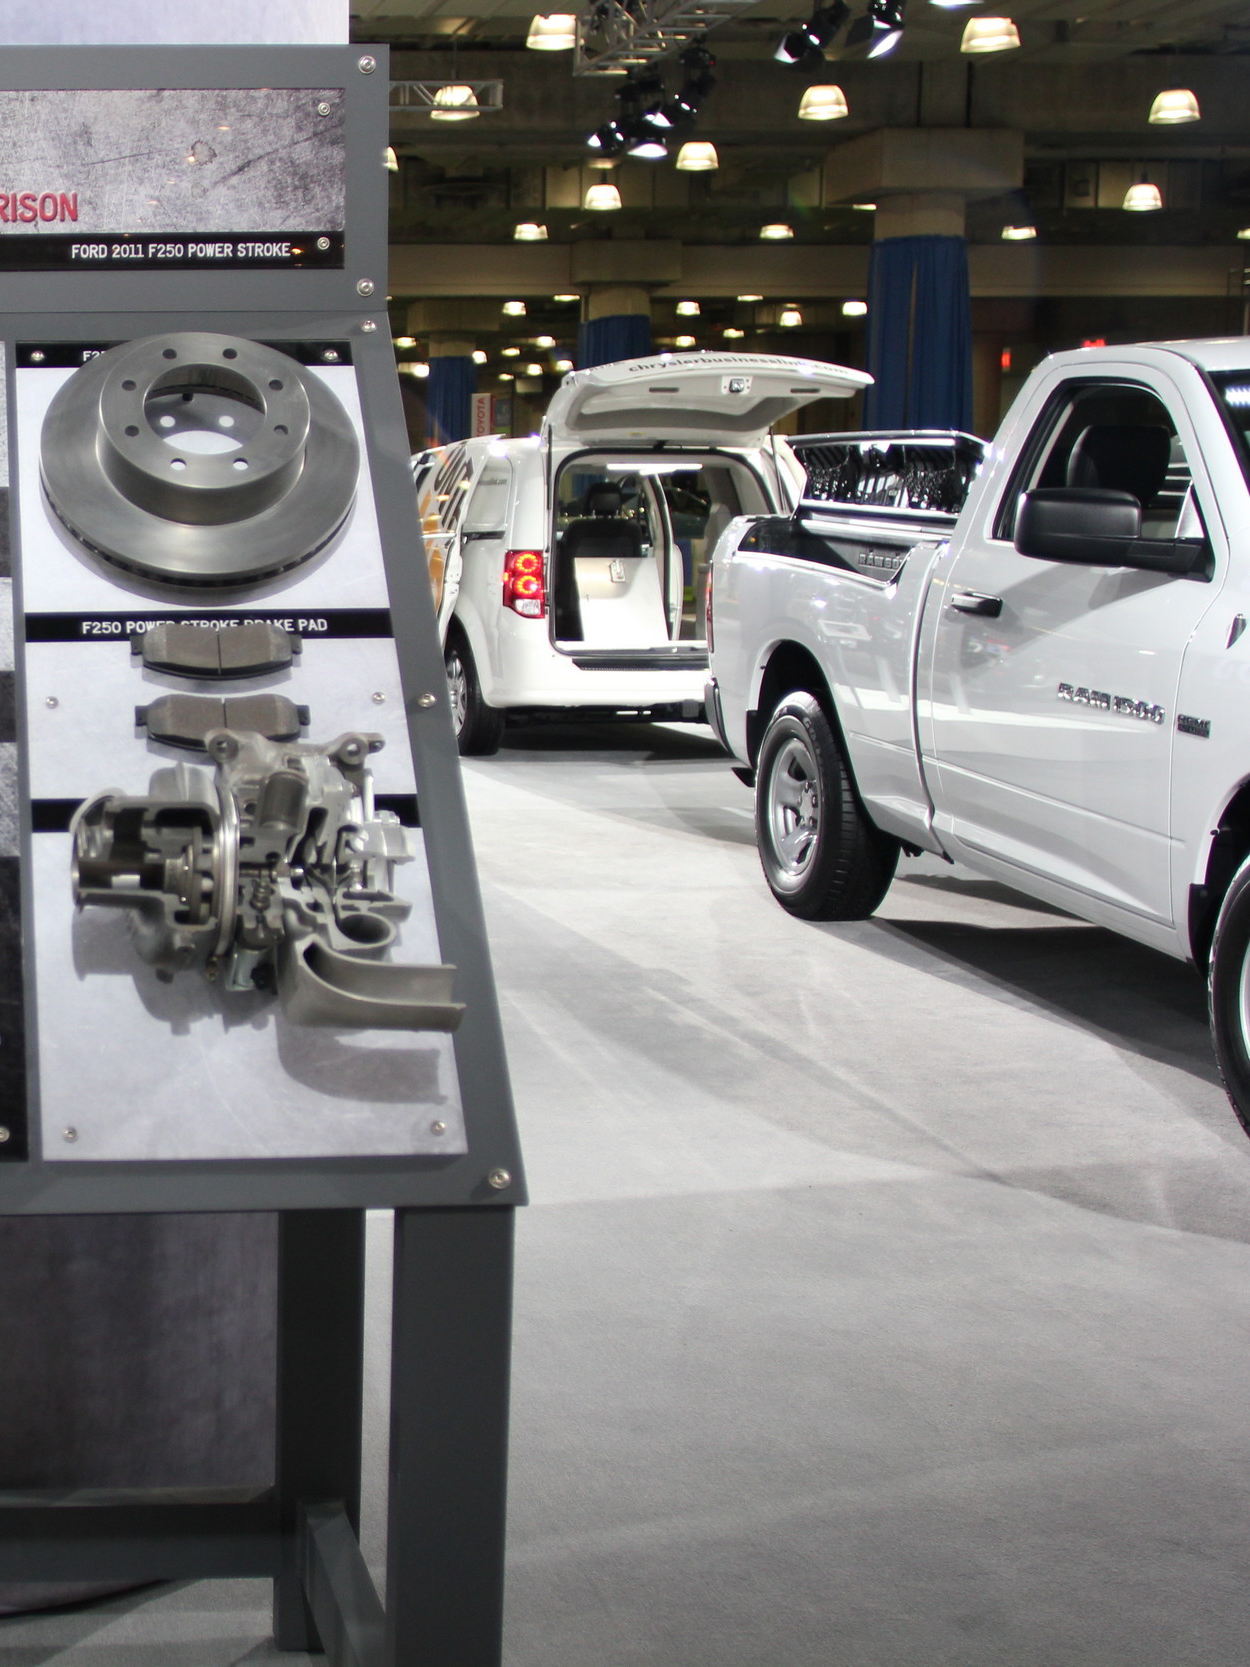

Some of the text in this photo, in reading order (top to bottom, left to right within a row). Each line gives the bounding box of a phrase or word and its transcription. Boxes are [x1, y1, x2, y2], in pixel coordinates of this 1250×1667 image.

[71, 242, 291, 259] FORD 2011 F250 POWER STROKE
[476, 397, 486, 437] OYOTA
[81, 621, 122, 634] F250
[126, 620, 176, 634] POW
[298, 618, 328, 631] PAD
